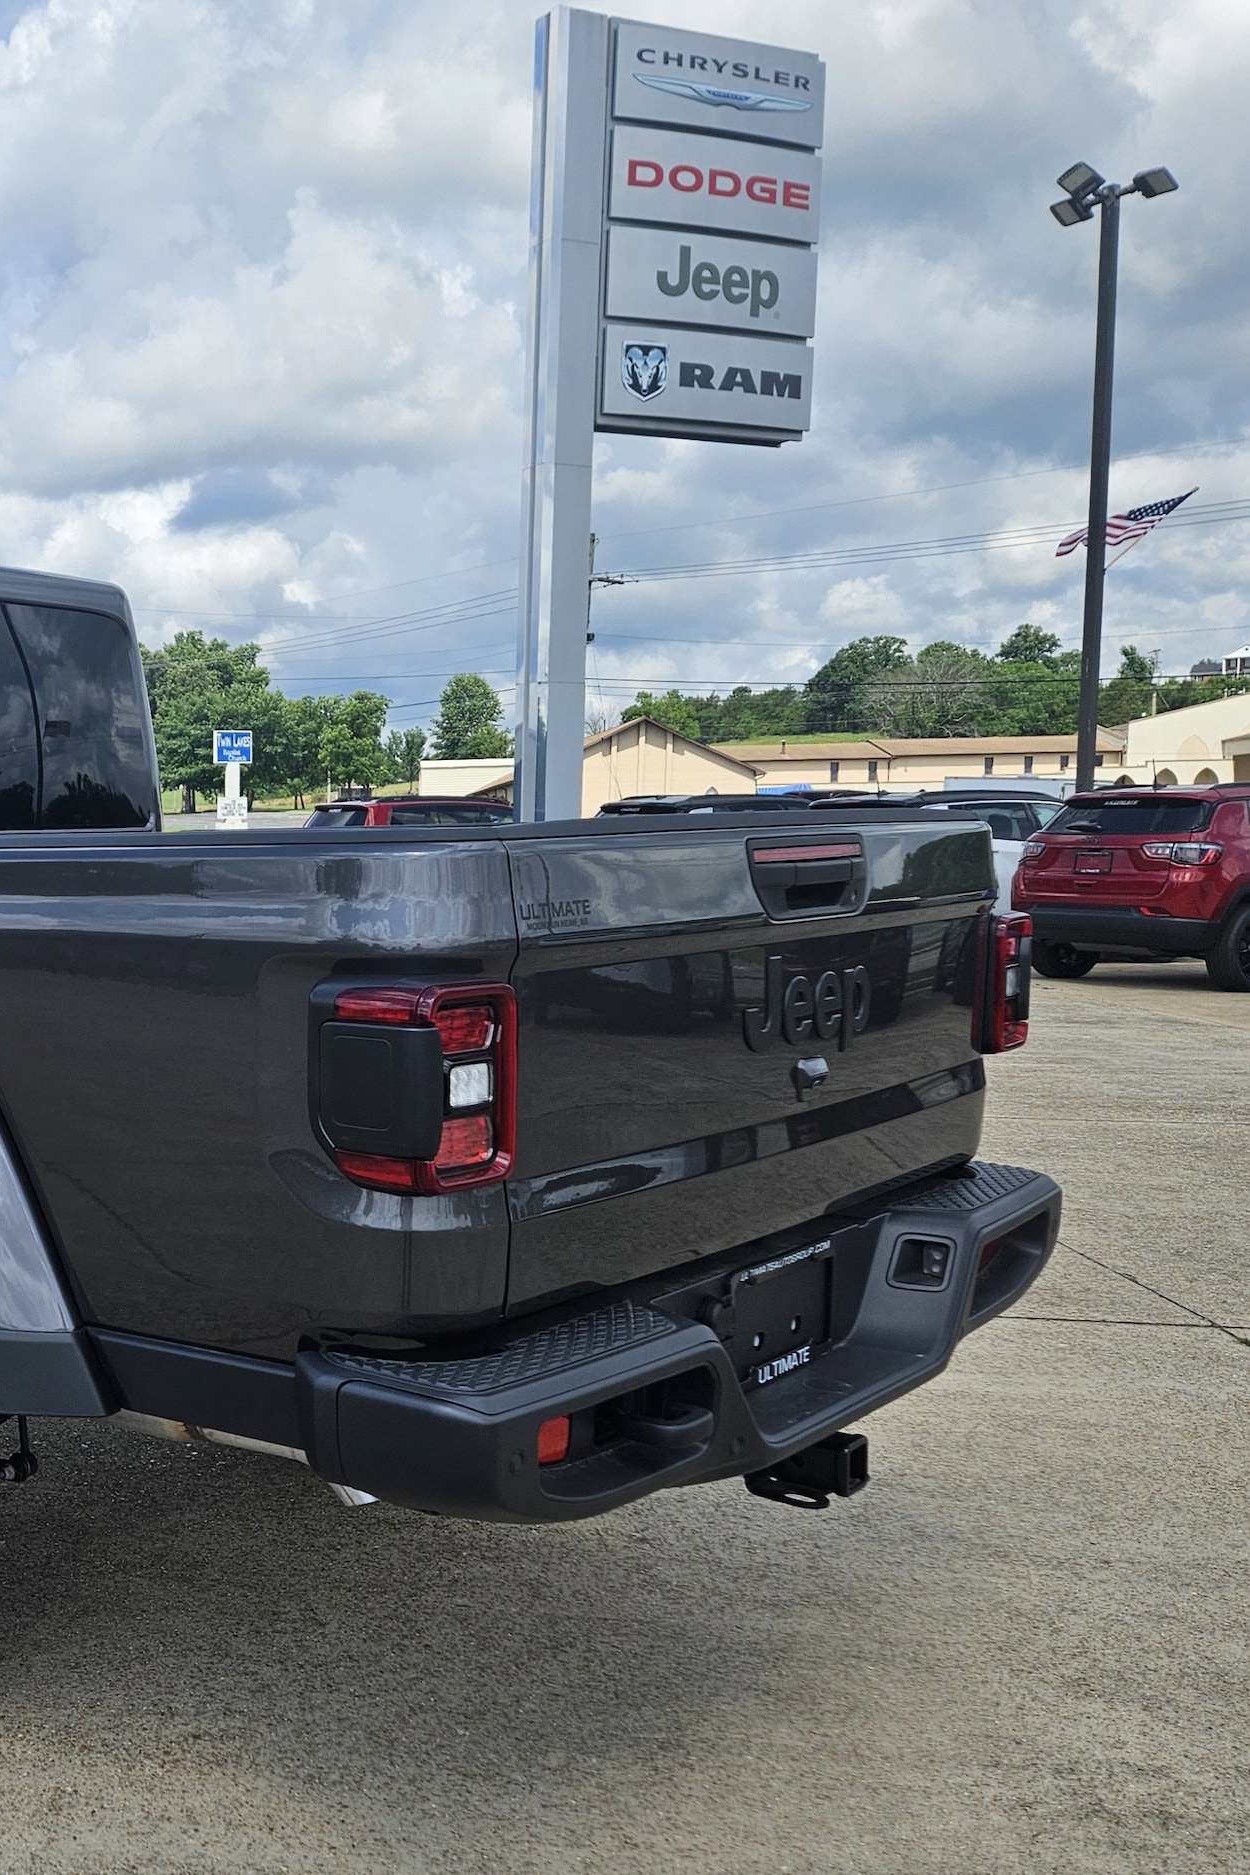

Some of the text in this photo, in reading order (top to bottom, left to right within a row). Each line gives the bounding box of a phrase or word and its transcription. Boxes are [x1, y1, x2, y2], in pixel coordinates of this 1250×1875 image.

[636, 48, 810, 91] CHRYSLER
[627, 159, 810, 210] DODGE
[656, 245, 779, 318] Jeep
[679, 361, 802, 400] RAM
[519, 899, 590, 920] ULTIMATE
[742, 955, 870, 1053] Jeep
[758, 1345, 810, 1384] ULTIMATE
